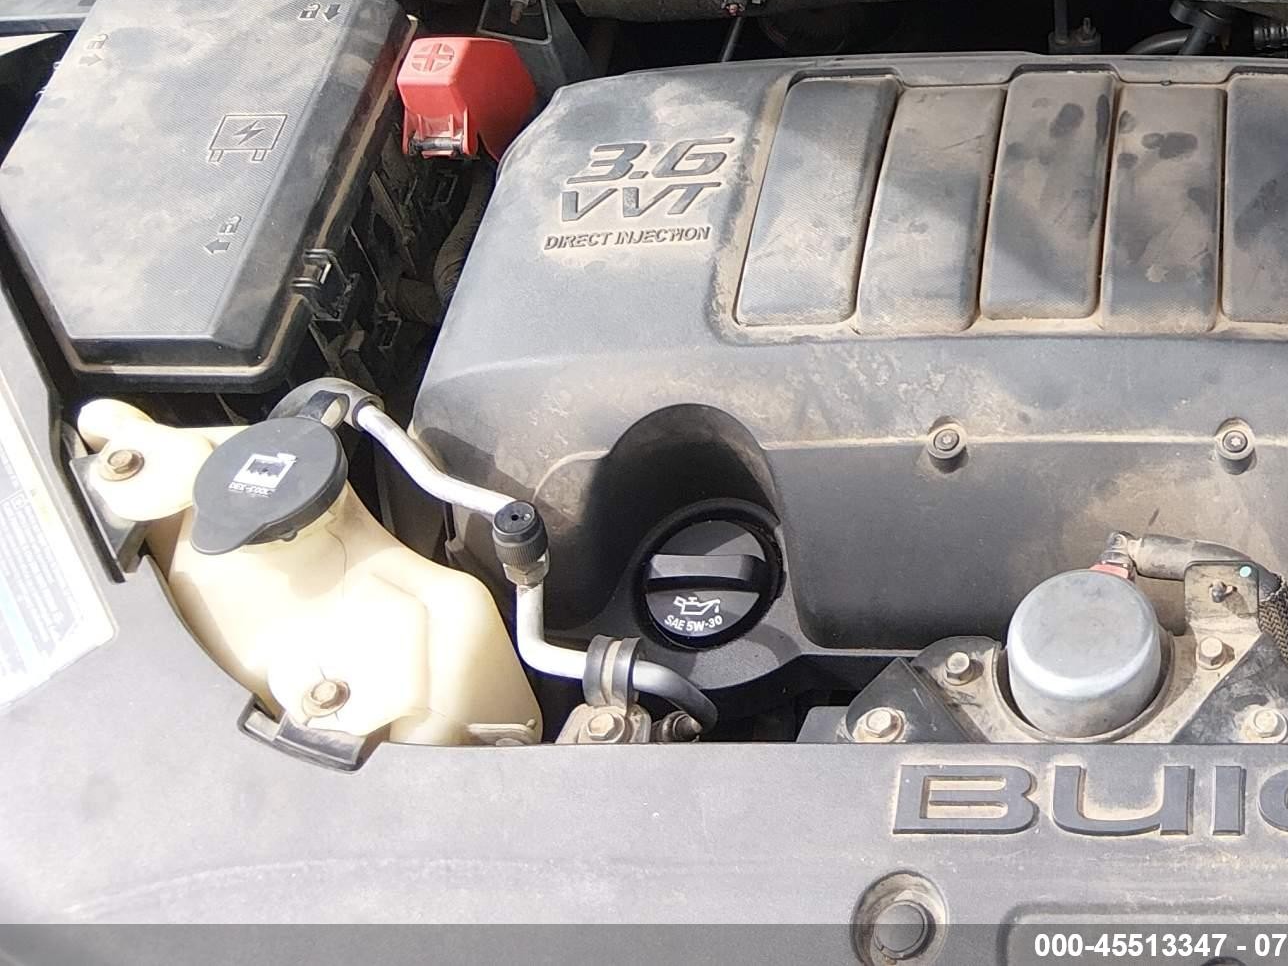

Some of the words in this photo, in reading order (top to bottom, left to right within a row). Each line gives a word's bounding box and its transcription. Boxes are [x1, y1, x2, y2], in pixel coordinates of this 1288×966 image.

[567, 137, 735, 185] 3.6
[562, 182, 722, 222] VVT
[544, 231, 613, 250] DIRECT
[614, 226, 712, 246] INJECTION
[664, 614, 686, 631] SAE
[686, 615, 723, 632] 5W-30
